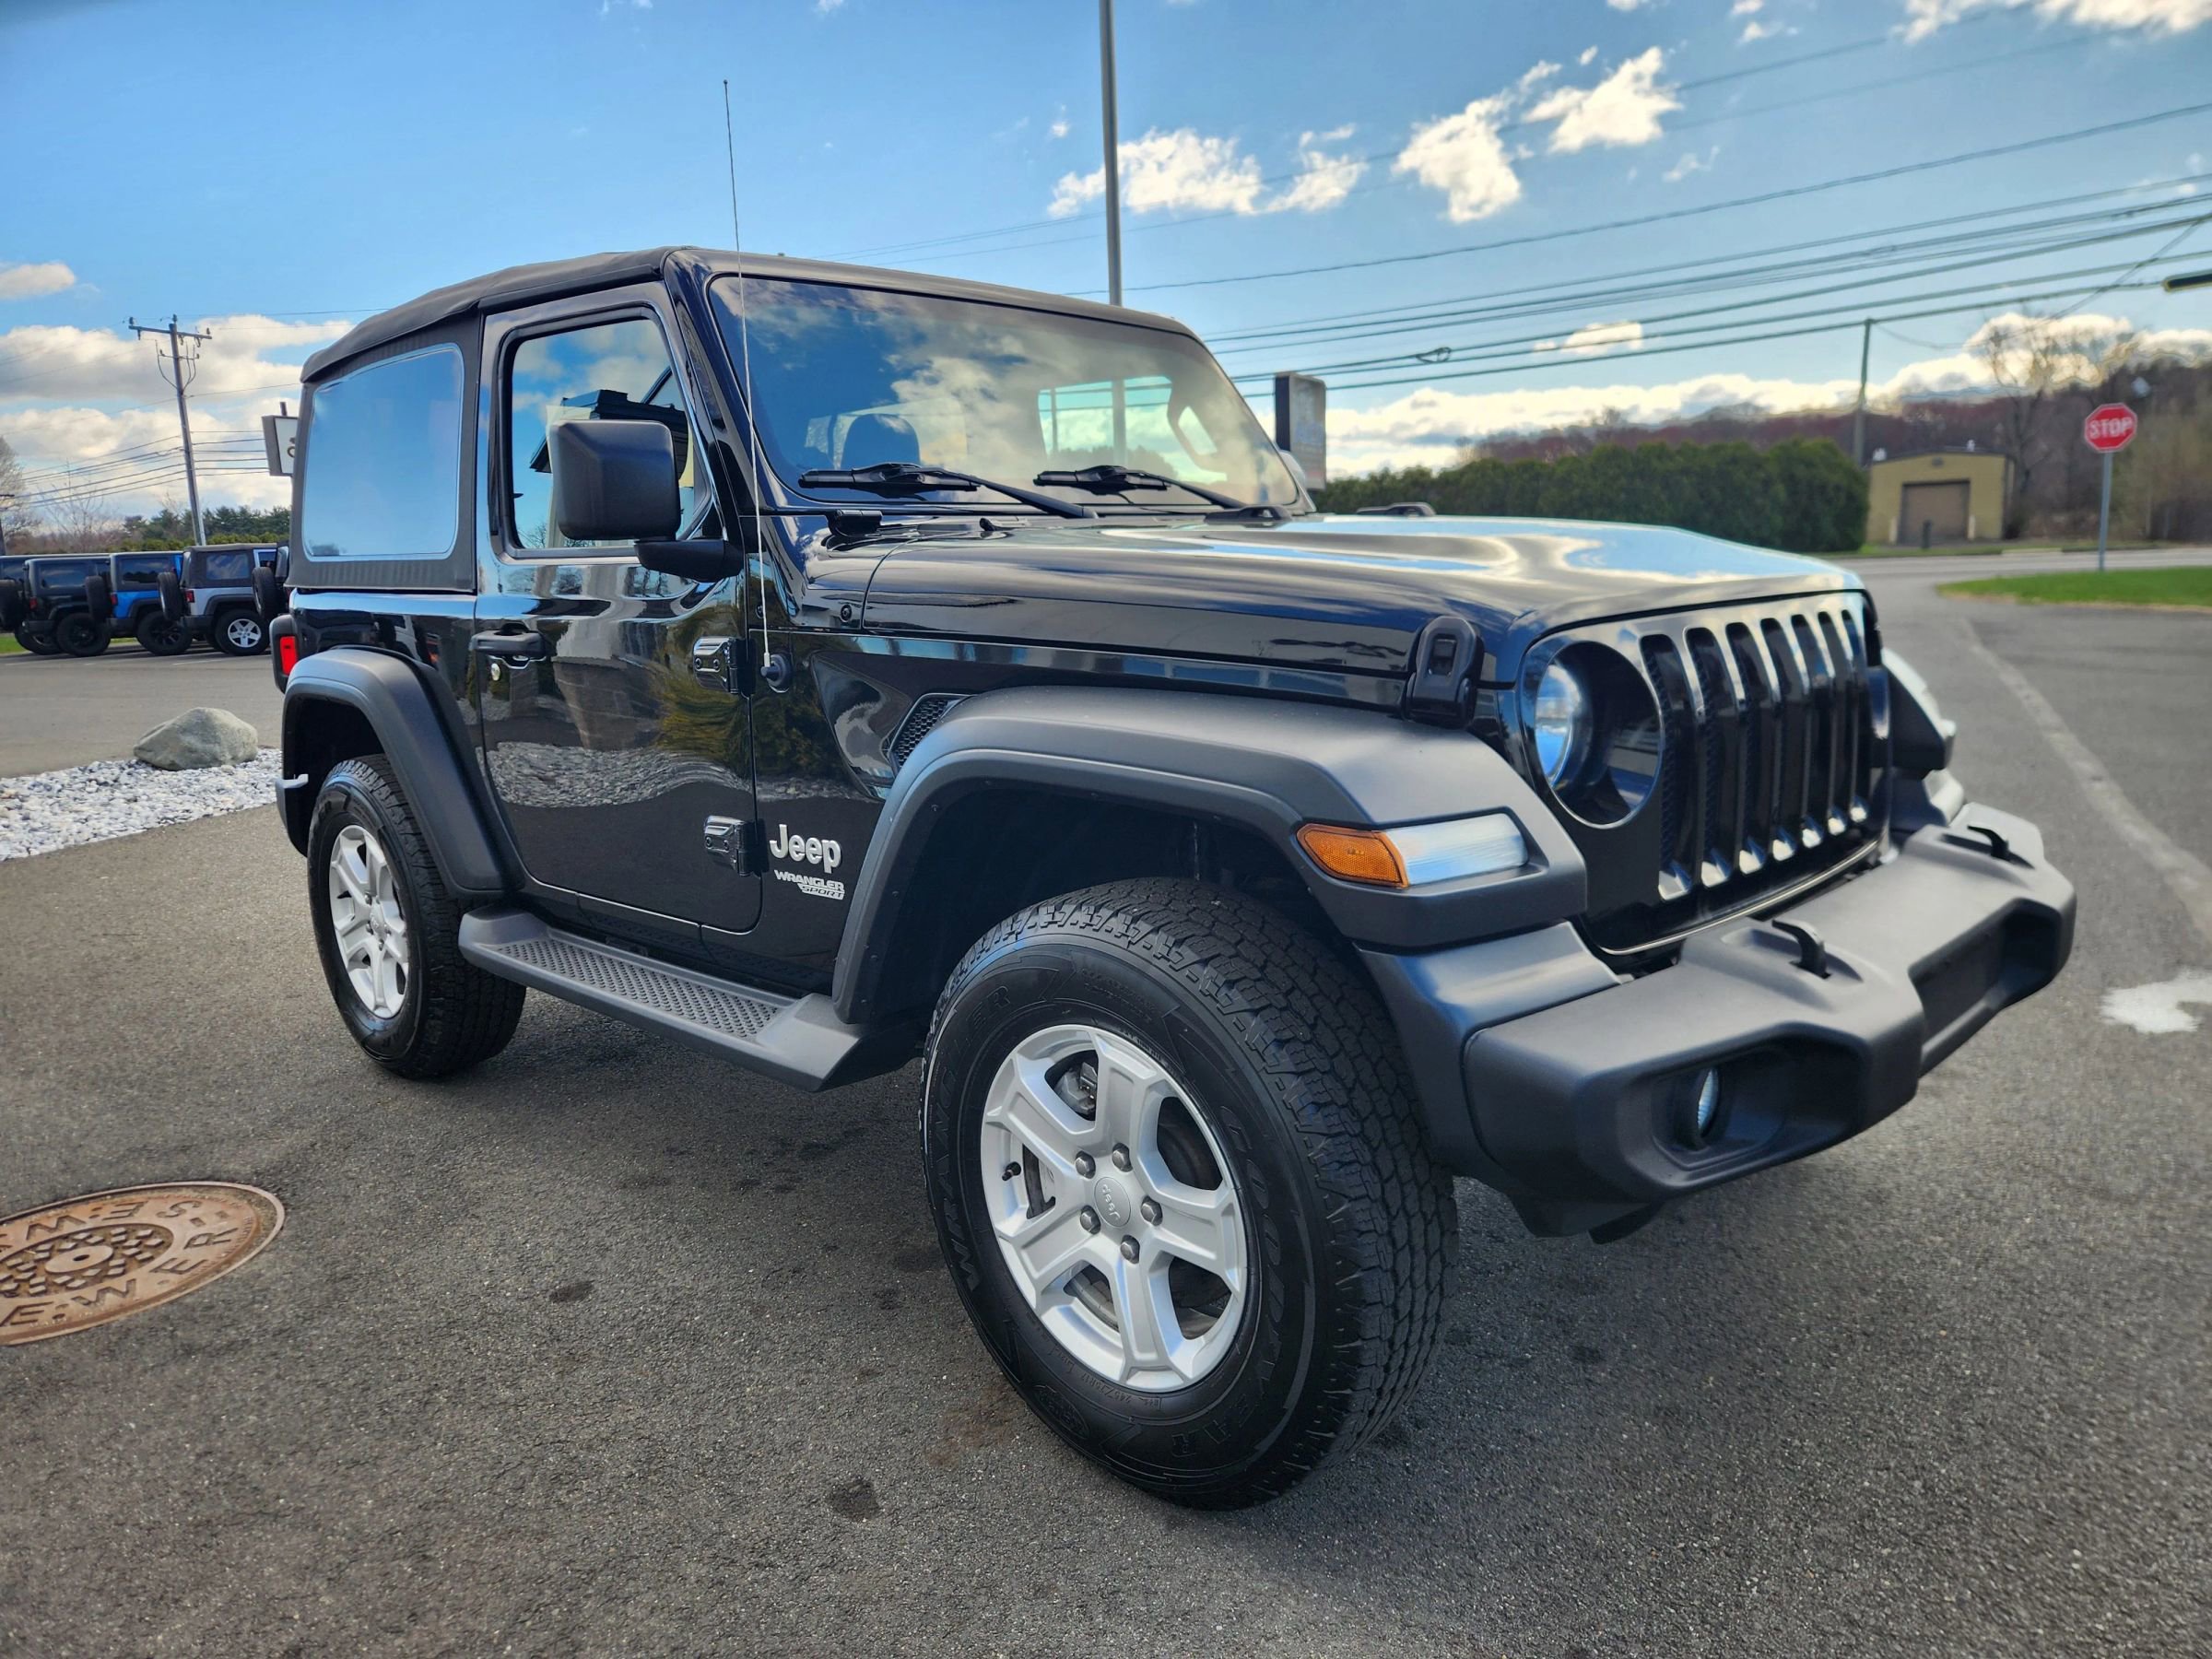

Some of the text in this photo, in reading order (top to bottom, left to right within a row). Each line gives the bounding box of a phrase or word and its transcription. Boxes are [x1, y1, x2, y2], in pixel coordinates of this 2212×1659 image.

[2089, 417, 2133, 439] STOP
[770, 823, 841, 874] Jeep
[774, 869, 844, 891] WRANGLER
[799, 885, 843, 900] SPORT
